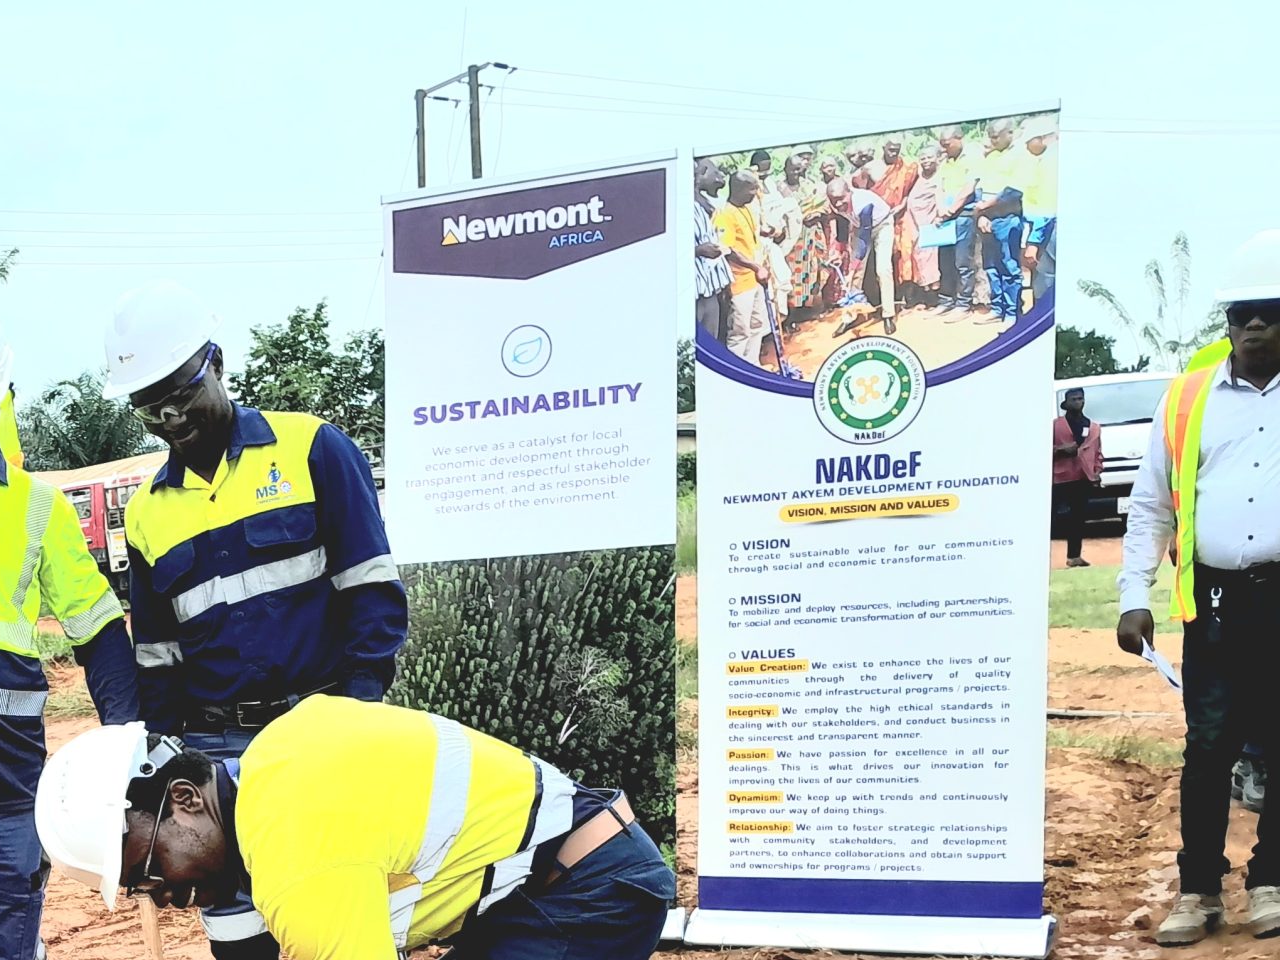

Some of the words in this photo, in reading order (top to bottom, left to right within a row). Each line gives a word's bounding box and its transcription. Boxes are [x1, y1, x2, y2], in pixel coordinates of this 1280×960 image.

[442, 196, 605, 246] Newmont
[549, 230, 604, 248] AFRICA
[827, 350, 848, 371] AKYEM
[850, 341, 906, 355] DEVELOPMENT
[412, 382, 643, 425] SUSTAINABILITY
[431, 446, 451, 456] We
[454, 443, 488, 454] serve
[491, 441, 505, 451] as
[518, 434, 567, 448] catalyst
[570, 431, 588, 442] for
[591, 427, 623, 443] local
[425, 457, 488, 472] economic
[489, 448, 572, 466] development
[575, 443, 629, 460] through
[405, 473, 476, 487] transparent
[480, 469, 504, 481] and
[507, 462, 570, 479] respectful
[573, 456, 651, 472] stakeholder
[815, 450, 921, 484] NAKDeF
[511, 481, 535, 493] and
[538, 481, 553, 491] as
[555, 472, 630, 491] responsible
[722, 491, 787, 504] NEWMONT
[791, 487, 834, 499] AKYEM
[838, 480, 932, 496] DEVELOPMENT
[936, 474, 1019, 489] FOUNDATION
[434, 500, 490, 514] stewards
[493, 498, 506, 509] of
[508, 497, 530, 508] the
[787, 506, 826, 517] VISION,
[829, 503, 876, 514] MISSION
[879, 501, 903, 511] AND
[906, 498, 950, 509] VALUES
[741, 537, 790, 550] VISION
[747, 552, 780, 561] create
[789, 546, 849, 558] sustainable
[857, 545, 885, 554] value
[893, 543, 909, 551] for
[917, 543, 936, 551] our
[944, 538, 1014, 549] communities
[727, 563, 768, 573] through
[772, 561, 802, 571] social
[806, 560, 824, 569] and
[827, 557, 876, 567] economic
[880, 553, 968, 564] transformation.
[740, 592, 801, 605] MISSION
[742, 607, 780, 616] mobilize
[783, 605, 801, 614] and
[805, 604, 836, 614] deploy
[840, 602, 891, 611] resources,
[896, 599, 940, 608] including
[943, 596, 1011, 608] partnerships,
[744, 618, 771, 627] social
[773, 617, 790, 626] and
[793, 615, 837, 625] economic
[840, 612, 914, 623] transformation
[949, 608, 1015, 618] communities.
[740, 648, 795, 660] VALUES
[727, 664, 754, 673] Value
[759, 663, 805, 672] Creation:
[810, 661, 827, 669] We
[831, 661, 857, 669] exist
[878, 658, 921, 667] enhance
[926, 657, 943, 665] the
[949, 656, 972, 664] lives
[728, 676, 789, 686] communities
[804, 674, 844, 684] through
[859, 673, 877, 681] the
[892, 672, 933, 680] delivery
[974, 669, 1011, 679] quality
[728, 690, 800, 699] socio-economic
[804, 688, 822, 696] and
[824, 685, 901, 696] infrastructural
[904, 686, 954, 695] programs
[963, 684, 1013, 693] projects.
[728, 707, 774, 717] Integrity:
[781, 706, 797, 714] We
[804, 705, 838, 715] employ
[845, 704, 862, 713] the
[869, 704, 890, 714] high
[897, 702, 933, 712] ethical
[940, 701, 993, 710] standards
[728, 721, 762, 730] dealing
[765, 720, 787, 728] with
[811, 718, 879, 727] stakeholders,
[883, 717, 901, 725] and
[905, 716, 946, 725] conduct
[950, 716, 996, 724] business
[728, 734, 744, 742] the
[796, 732, 814, 741] and
[817, 732, 879, 741] transparent
[728, 750, 768, 759] Passion:
[776, 750, 792, 758] We
[799, 750, 822, 758] have
[828, 749, 866, 759] passion
[873, 748, 888, 757] for
[894, 747, 947, 756] excellence
[728, 764, 770, 773] dealings.
[780, 763, 800, 771] This
[828, 762, 853, 770] what
[862, 762, 894, 770] drives
[930, 761, 984, 769] innovation
[993, 760, 1009, 768] for
[728, 776, 775, 786] improving
[777, 776, 794, 784] the
[797, 776, 820, 784] lives
[855, 775, 922, 783] communities.
[728, 793, 780, 803] Dynamism:
[785, 793, 801, 801] We
[807, 793, 829, 802] keep
[851, 792, 874, 801] with
[879, 792, 913, 800] trends
[919, 792, 937, 800] and
[942, 792, 1008, 802] continuously
[823, 806, 849, 815] doing
[852, 806, 887, 815] things.
[728, 822, 790, 832] Relationship:
[795, 822, 811, 831] We
[852, 823, 883, 831] foster
[887, 824, 934, 833] strategic
[939, 823, 1007, 833] relationships
[762, 837, 815, 845] community
[828, 836, 896, 845] stakeholders,
[942, 837, 1007, 847] development
[728, 849, 773, 857] partners,
[791, 849, 831, 857] enhance
[834, 849, 905, 858] collaborations
[908, 849, 927, 858] and
[930, 850, 962, 859] obtain
[966, 852, 1007, 860] support
[748, 861, 803, 871] ownerships
[823, 864, 870, 872] programs
[879, 864, 924, 872] projects.
